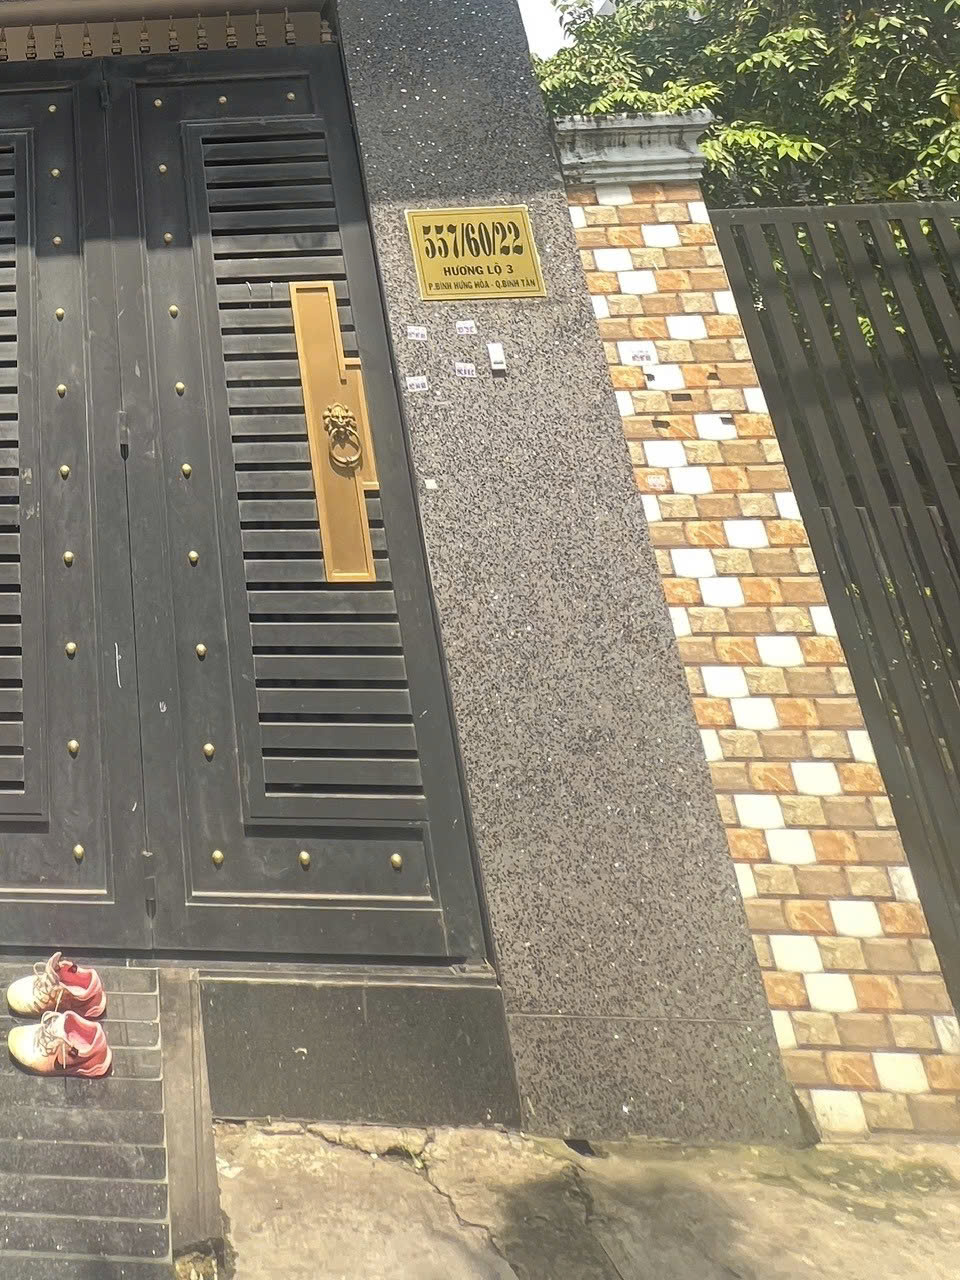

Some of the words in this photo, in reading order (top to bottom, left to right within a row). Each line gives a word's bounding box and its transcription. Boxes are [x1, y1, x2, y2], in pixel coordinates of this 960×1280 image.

[422, 221, 524, 259] 557/60/22
[443, 265, 484, 276] HƯƠNG
[486, 262, 502, 276] LỘ
[506, 264, 514, 274] 3
